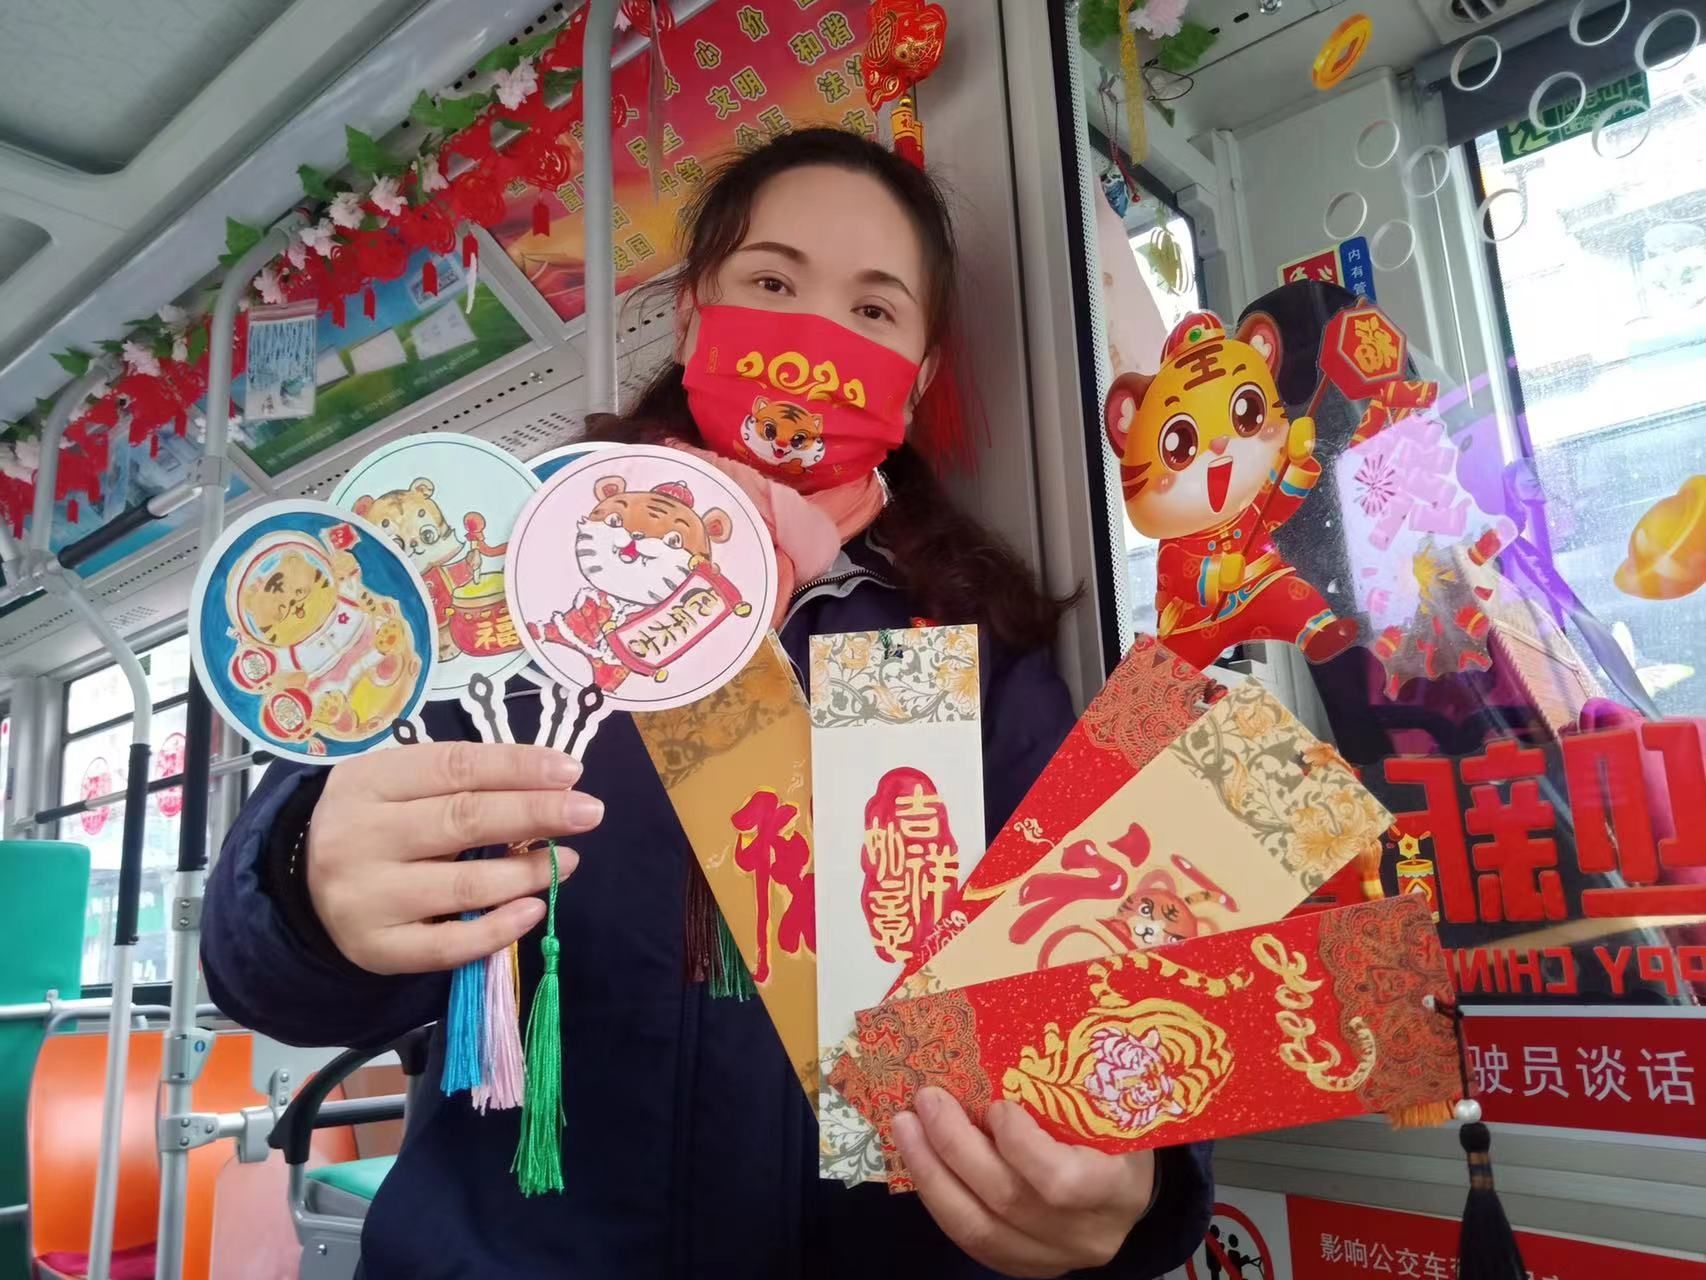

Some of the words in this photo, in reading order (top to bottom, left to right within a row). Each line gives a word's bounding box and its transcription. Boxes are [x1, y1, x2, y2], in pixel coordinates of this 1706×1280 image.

[708, 67, 766, 120] 文明
[789, 12, 855, 65] 和谐
[474, 606, 521, 651] 福
[1467, 1043, 1696, 1106] 驶员谈话
